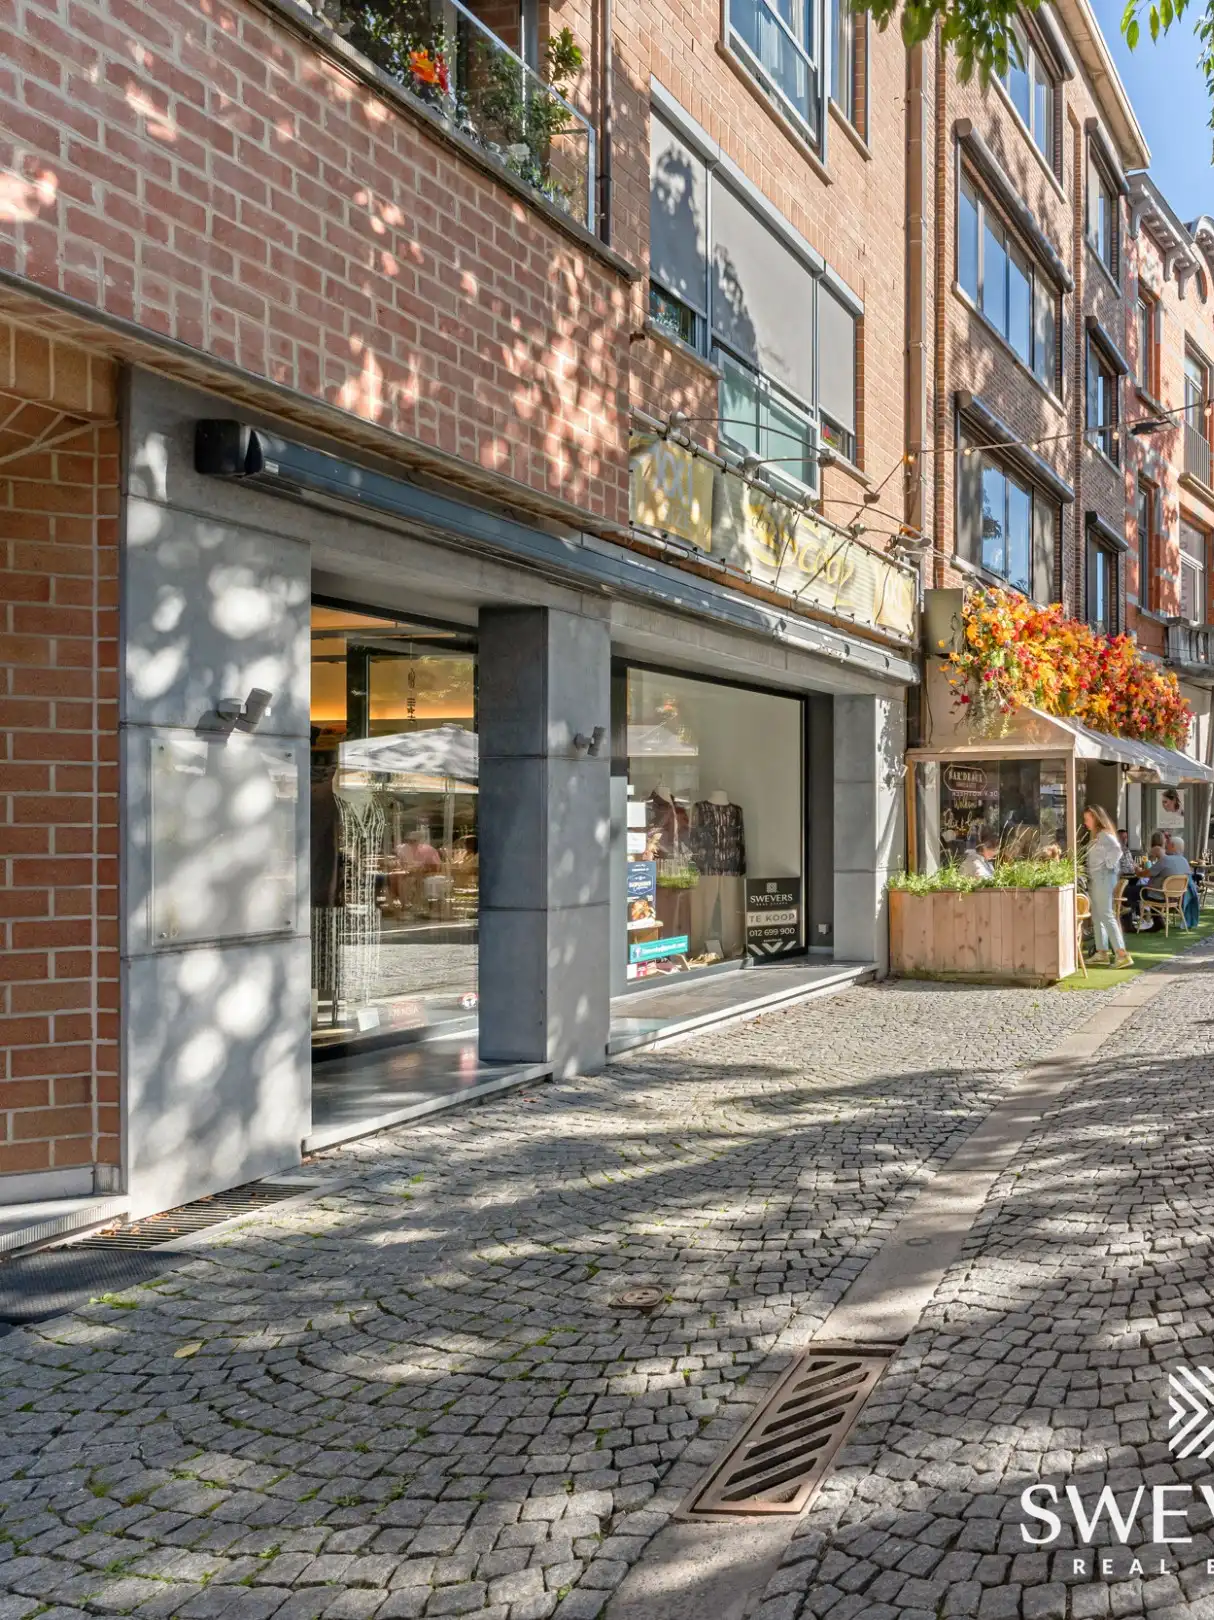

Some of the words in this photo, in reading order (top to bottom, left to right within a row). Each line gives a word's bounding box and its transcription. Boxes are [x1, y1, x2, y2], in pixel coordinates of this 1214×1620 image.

[750, 893, 793, 903] SWEVERS
[749, 915, 761, 923] TE
[765, 913, 795, 922] KOOP
[749, 929, 763, 937] 012
[764, 928, 779, 936] 699
[780, 927, 795, 935] 900
